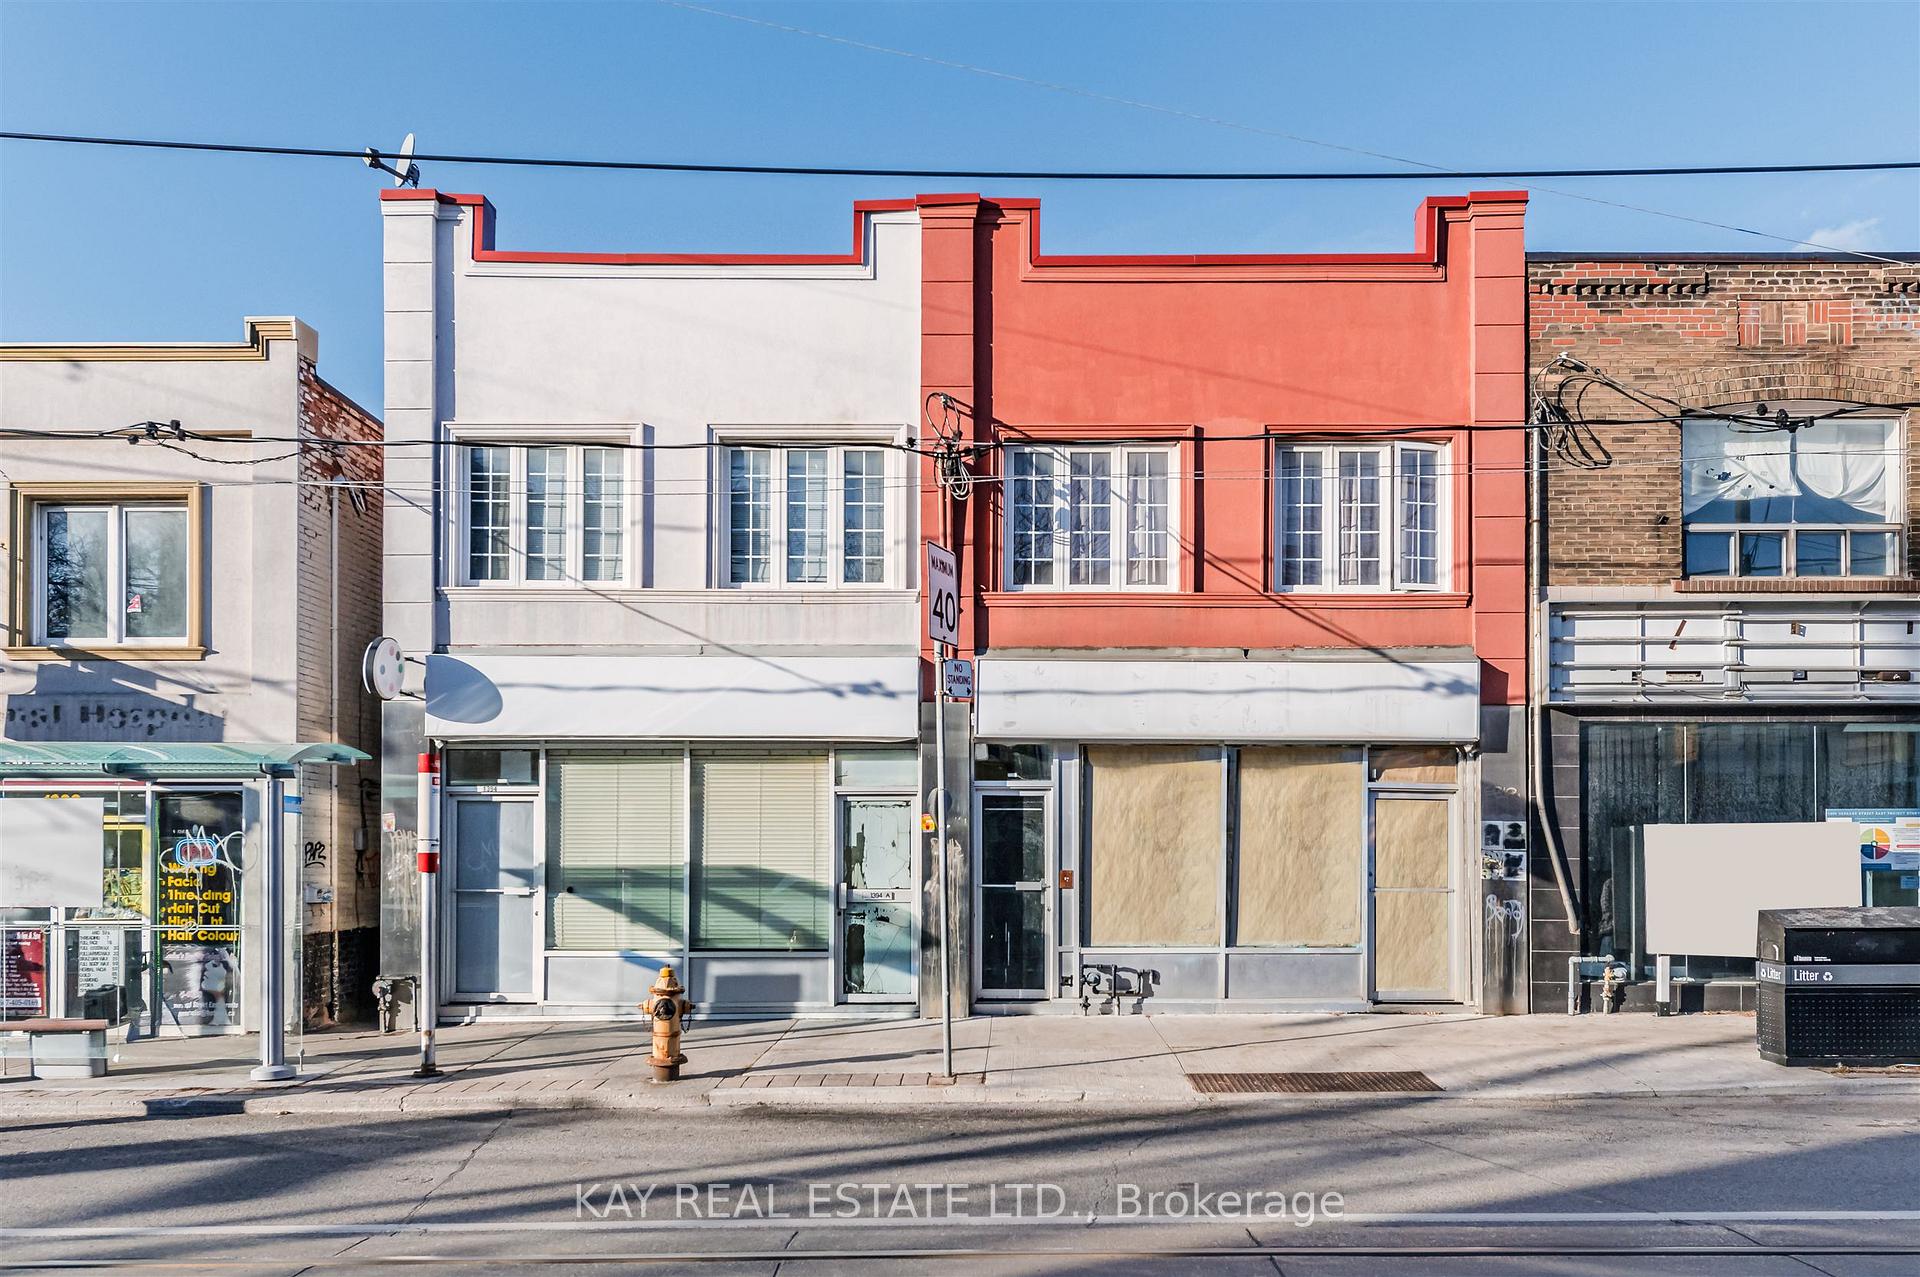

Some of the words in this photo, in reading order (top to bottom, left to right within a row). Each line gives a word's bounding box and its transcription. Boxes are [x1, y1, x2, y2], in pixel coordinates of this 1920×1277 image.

[931, 555, 954, 577] MAXIMUM
[933, 588, 956, 632] 40
[954, 663, 963, 673] NO
[947, 675, 971, 685] STANDING
[198, 903, 220, 913] Cut
[168, 930, 193, 940] Hair
[198, 930, 239, 941] Colour
[1767, 967, 1781, 980] Litter
[1794, 970, 1819, 981] Litter
